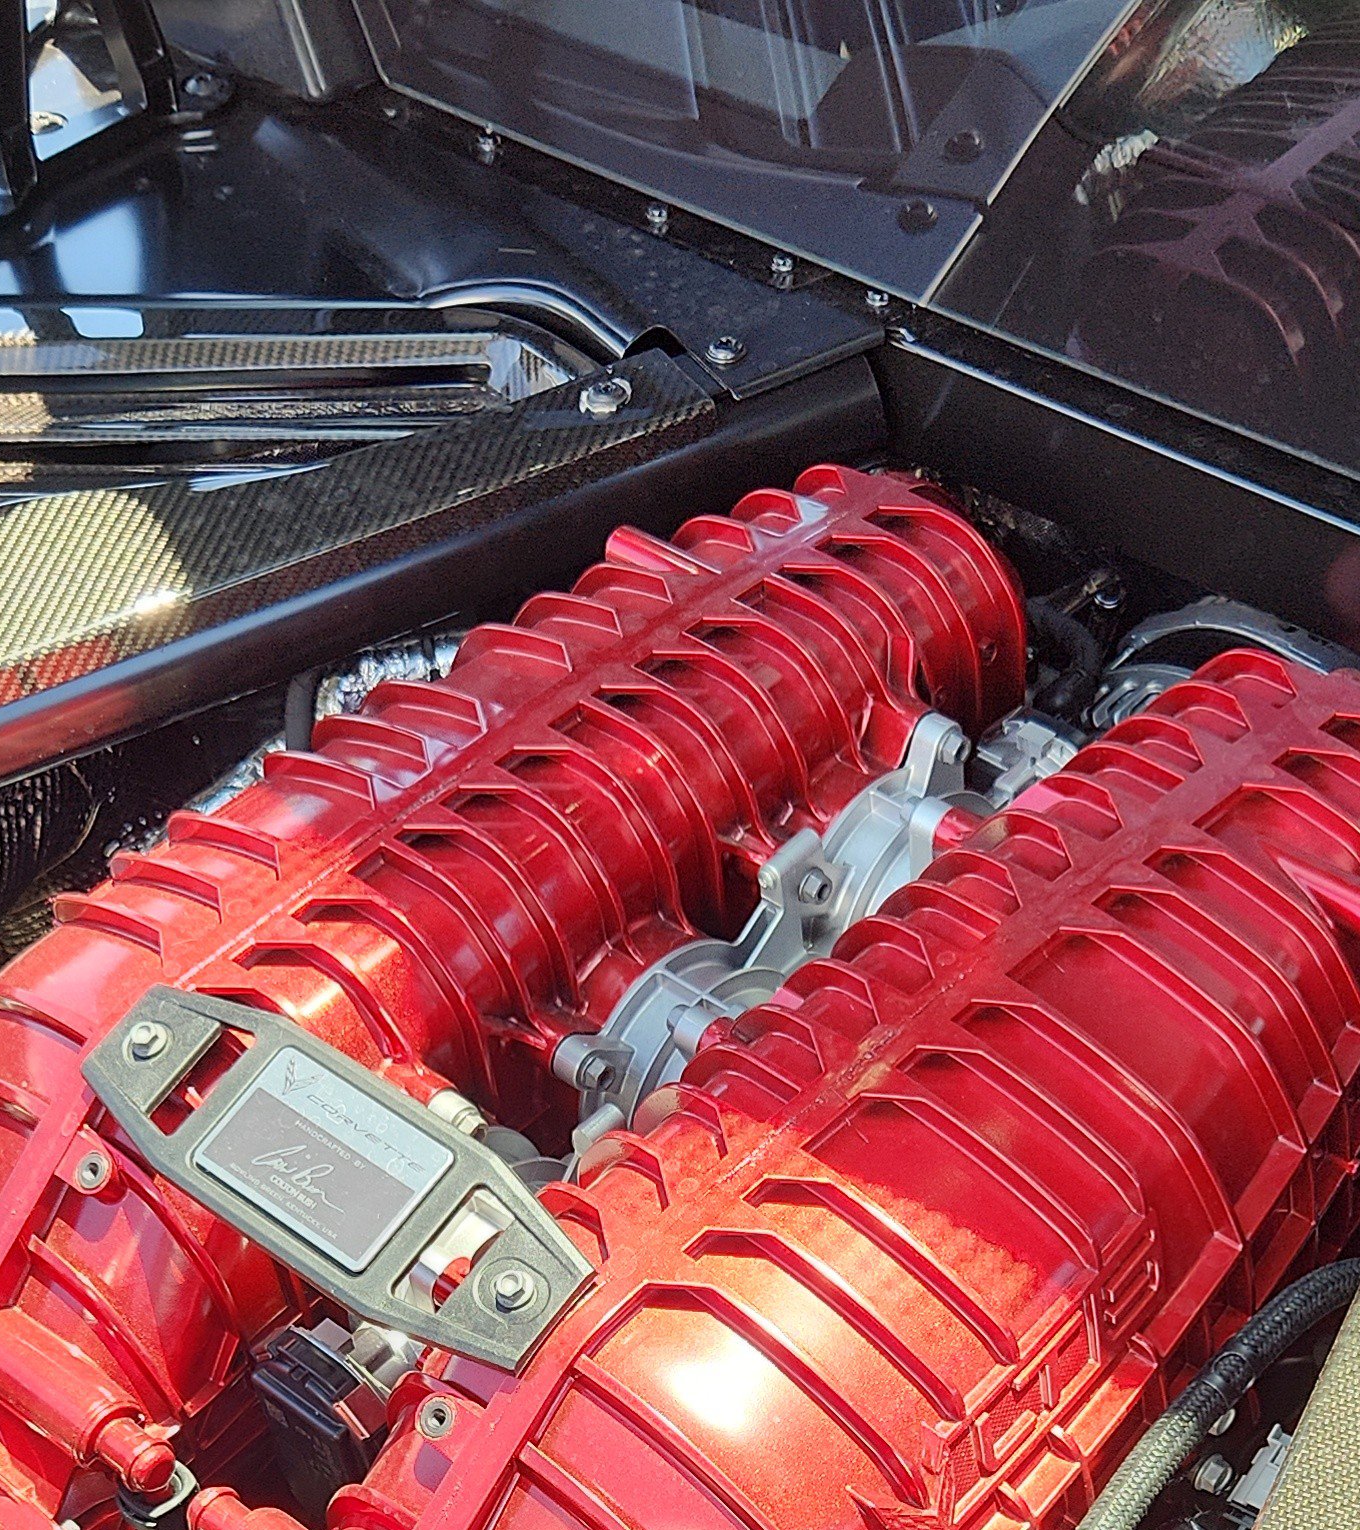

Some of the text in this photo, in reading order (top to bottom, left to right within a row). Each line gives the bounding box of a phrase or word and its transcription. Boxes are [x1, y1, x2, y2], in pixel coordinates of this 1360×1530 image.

[294, 1120, 367, 1171] HANDCRAFTED BY
[307, 1094, 426, 1173] CORVETTE
